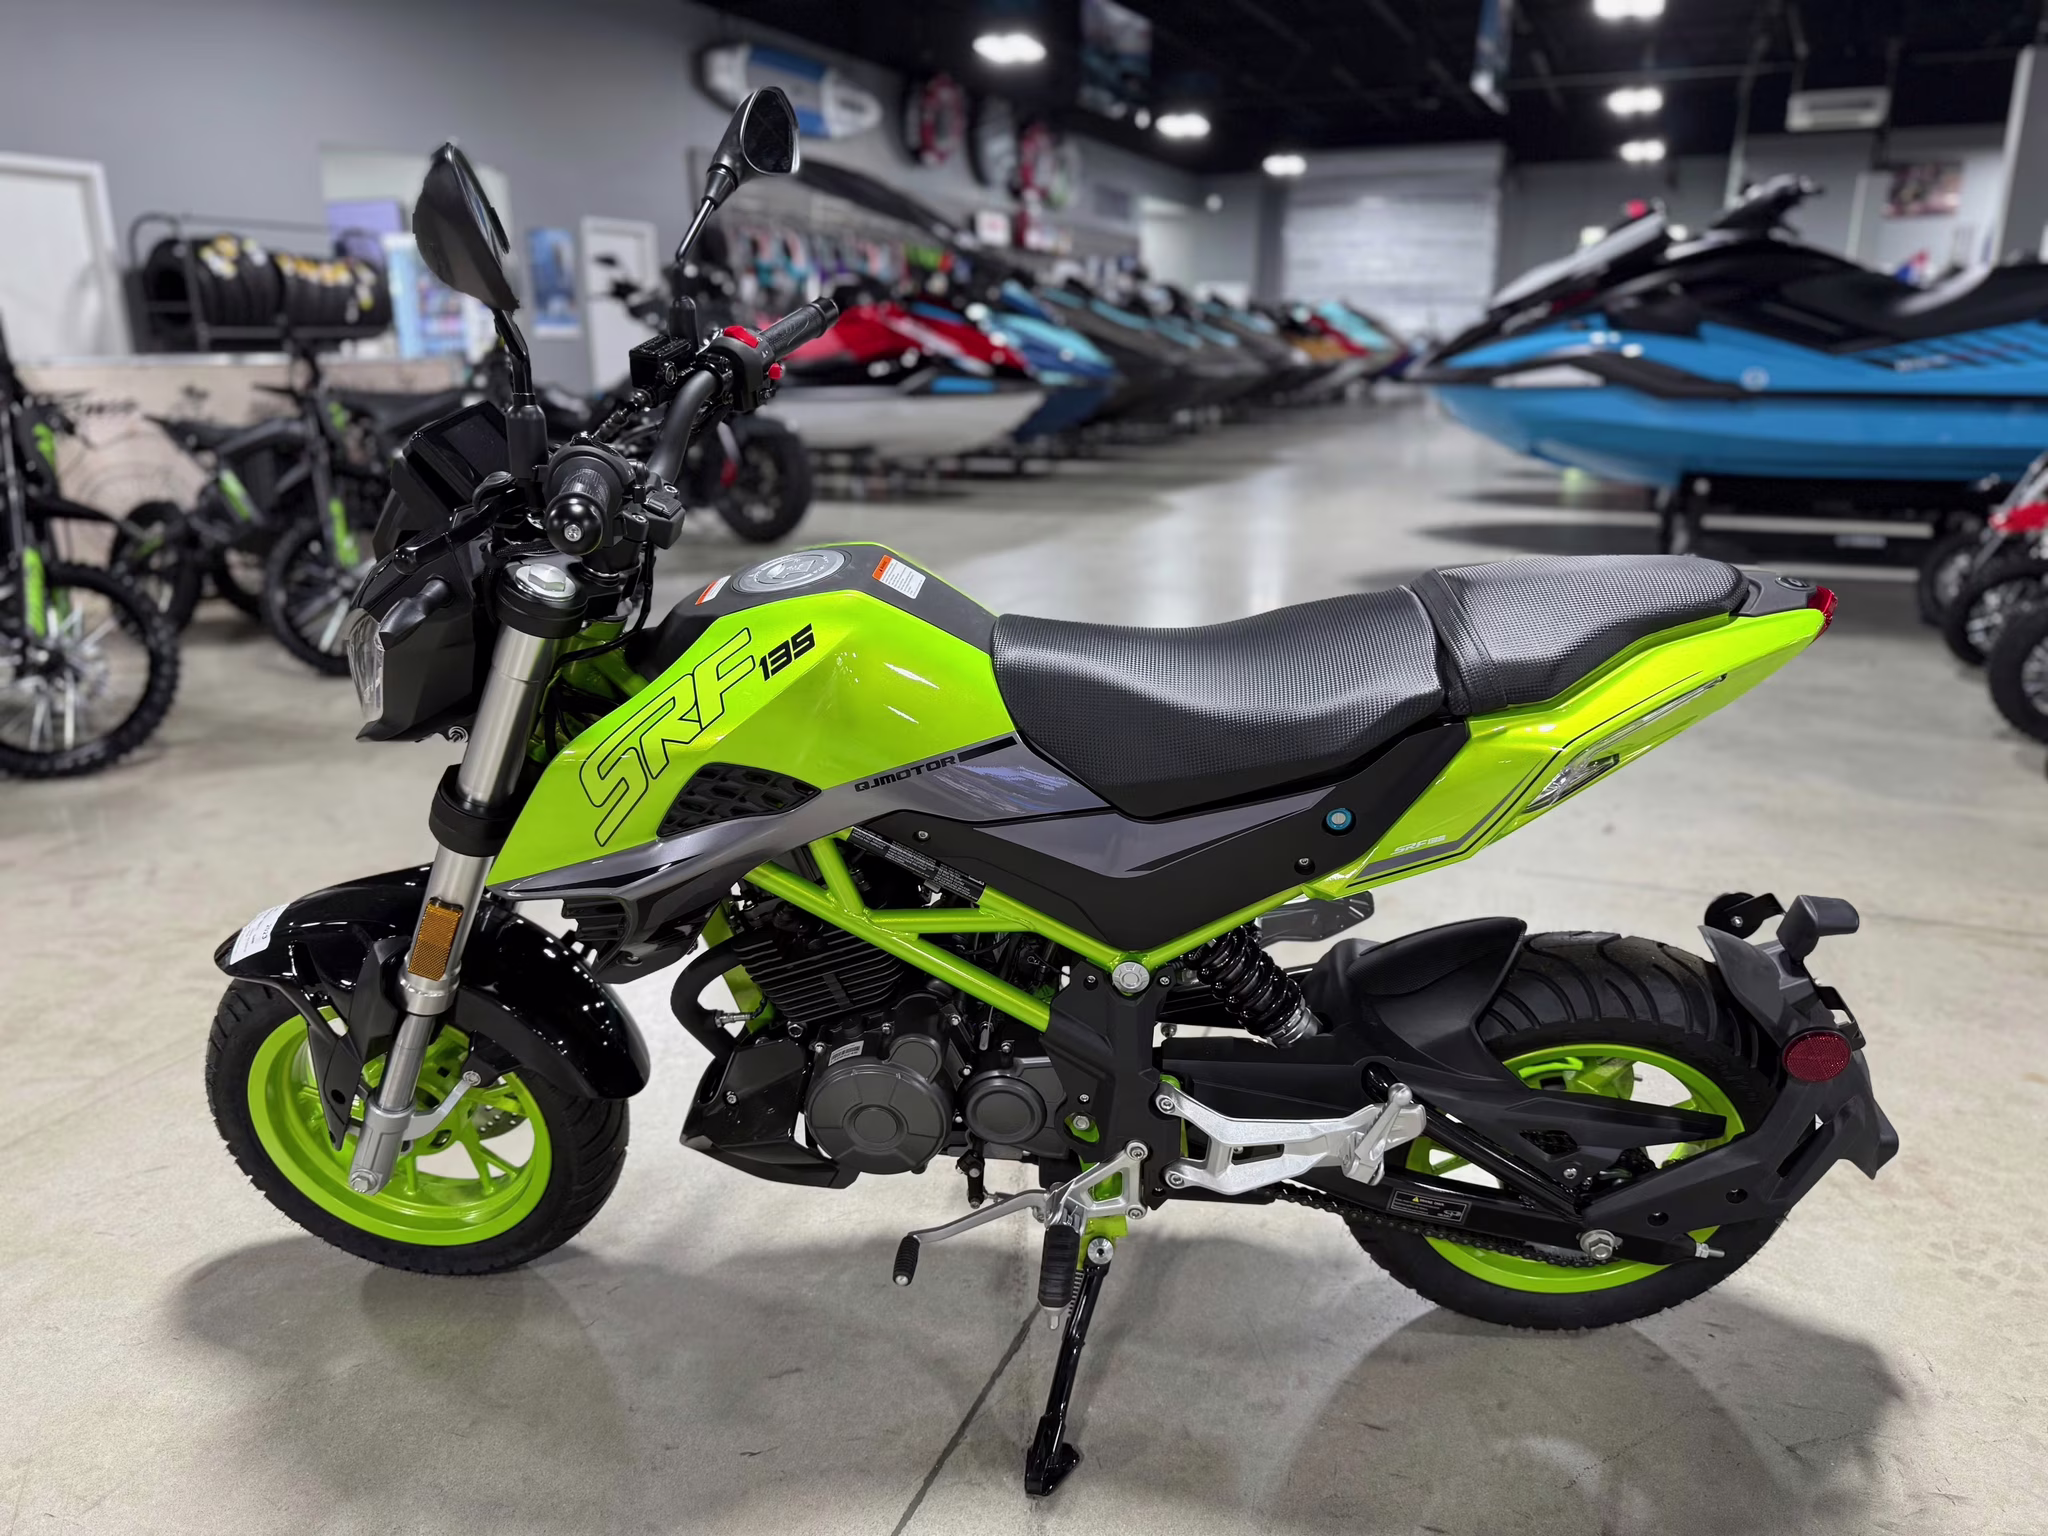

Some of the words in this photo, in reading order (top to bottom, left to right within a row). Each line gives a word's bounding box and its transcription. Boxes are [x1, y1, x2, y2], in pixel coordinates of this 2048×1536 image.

[579, 627, 756, 847] SRF
[758, 623, 816, 682] 135
[854, 755, 957, 792] QJMOTOR
